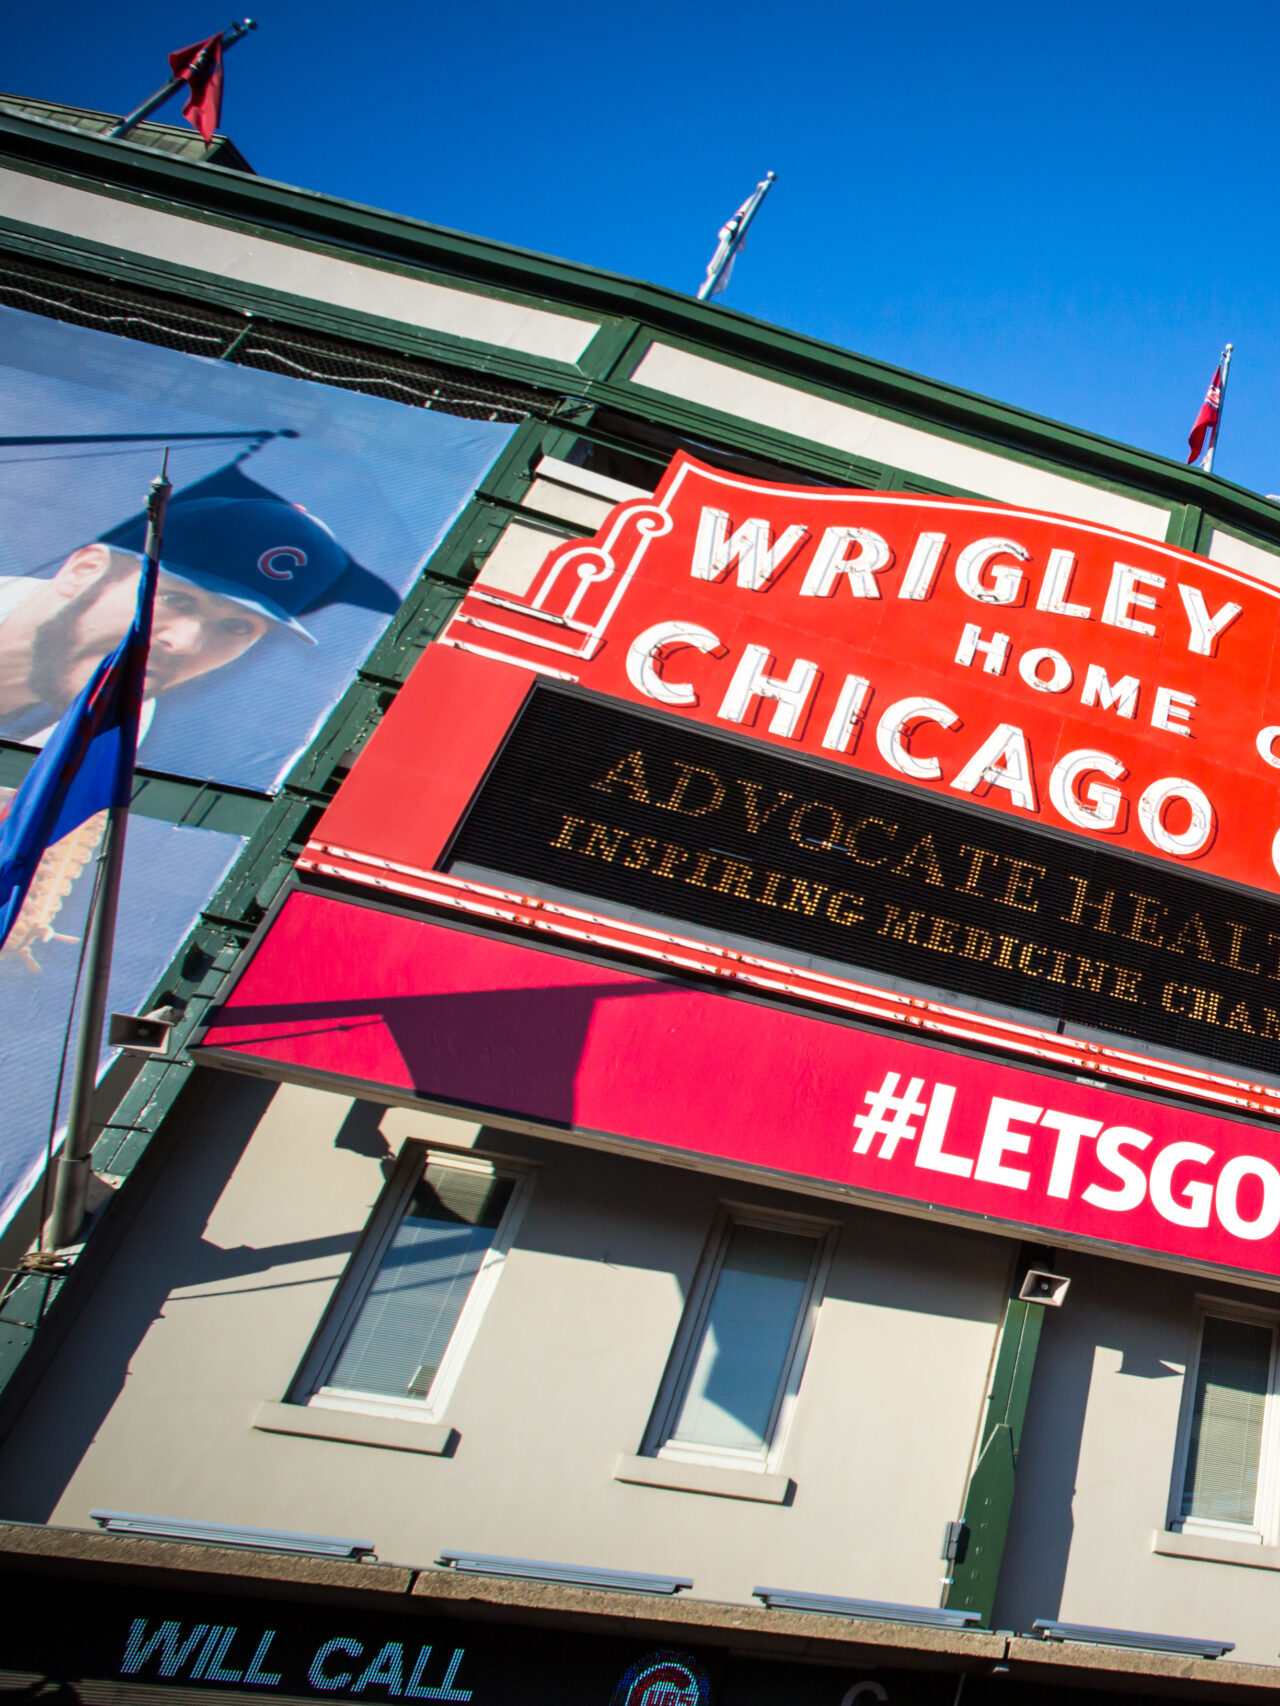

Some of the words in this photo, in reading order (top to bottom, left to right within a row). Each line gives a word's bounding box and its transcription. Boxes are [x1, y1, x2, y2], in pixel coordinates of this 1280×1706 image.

[257, 546, 308, 580] C
[690, 506, 1242, 657] WRIGLEY
[954, 622, 1197, 737] HOME
[625, 621, 1213, 856] CHICAGO
[549, 814, 865, 927] INSPIRING
[590, 750, 1048, 913] ADVOCATE
[119, 1618, 282, 1686] WILL
[307, 1637, 473, 1703] CALL
